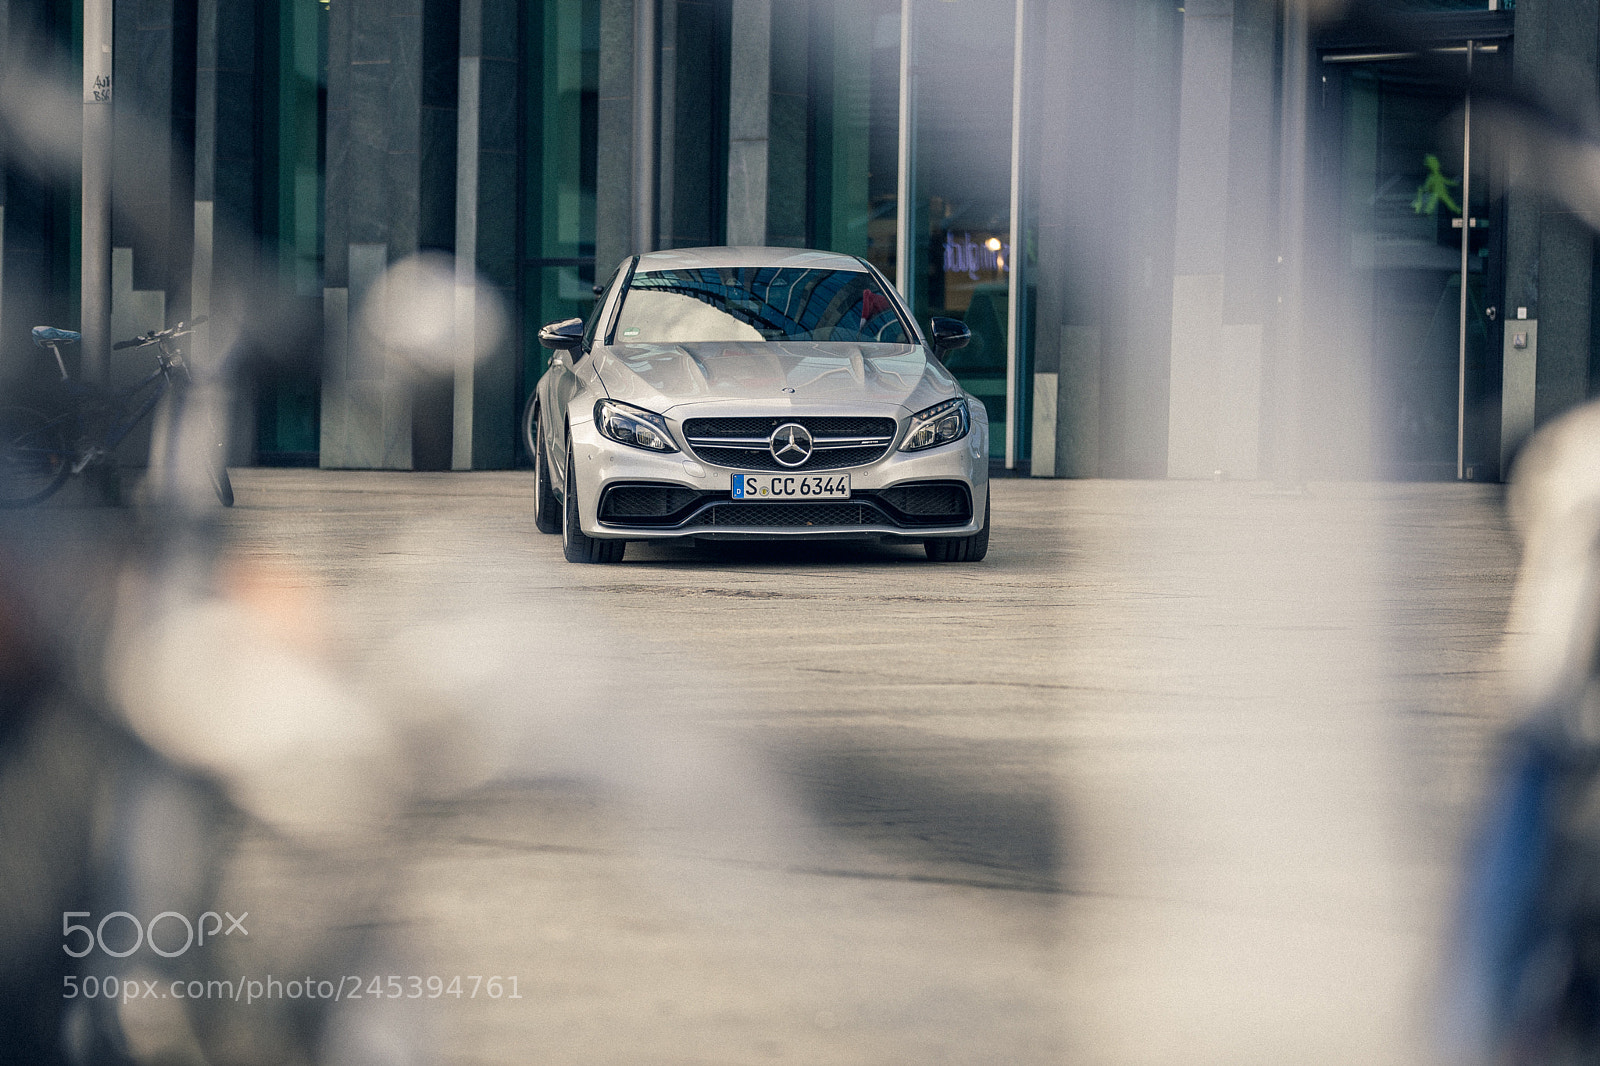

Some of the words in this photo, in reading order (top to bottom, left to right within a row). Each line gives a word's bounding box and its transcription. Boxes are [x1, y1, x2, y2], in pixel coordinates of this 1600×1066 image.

[745, 477, 757, 495] S
[771, 477, 796, 495] CC
[800, 477, 846, 495] 6344
